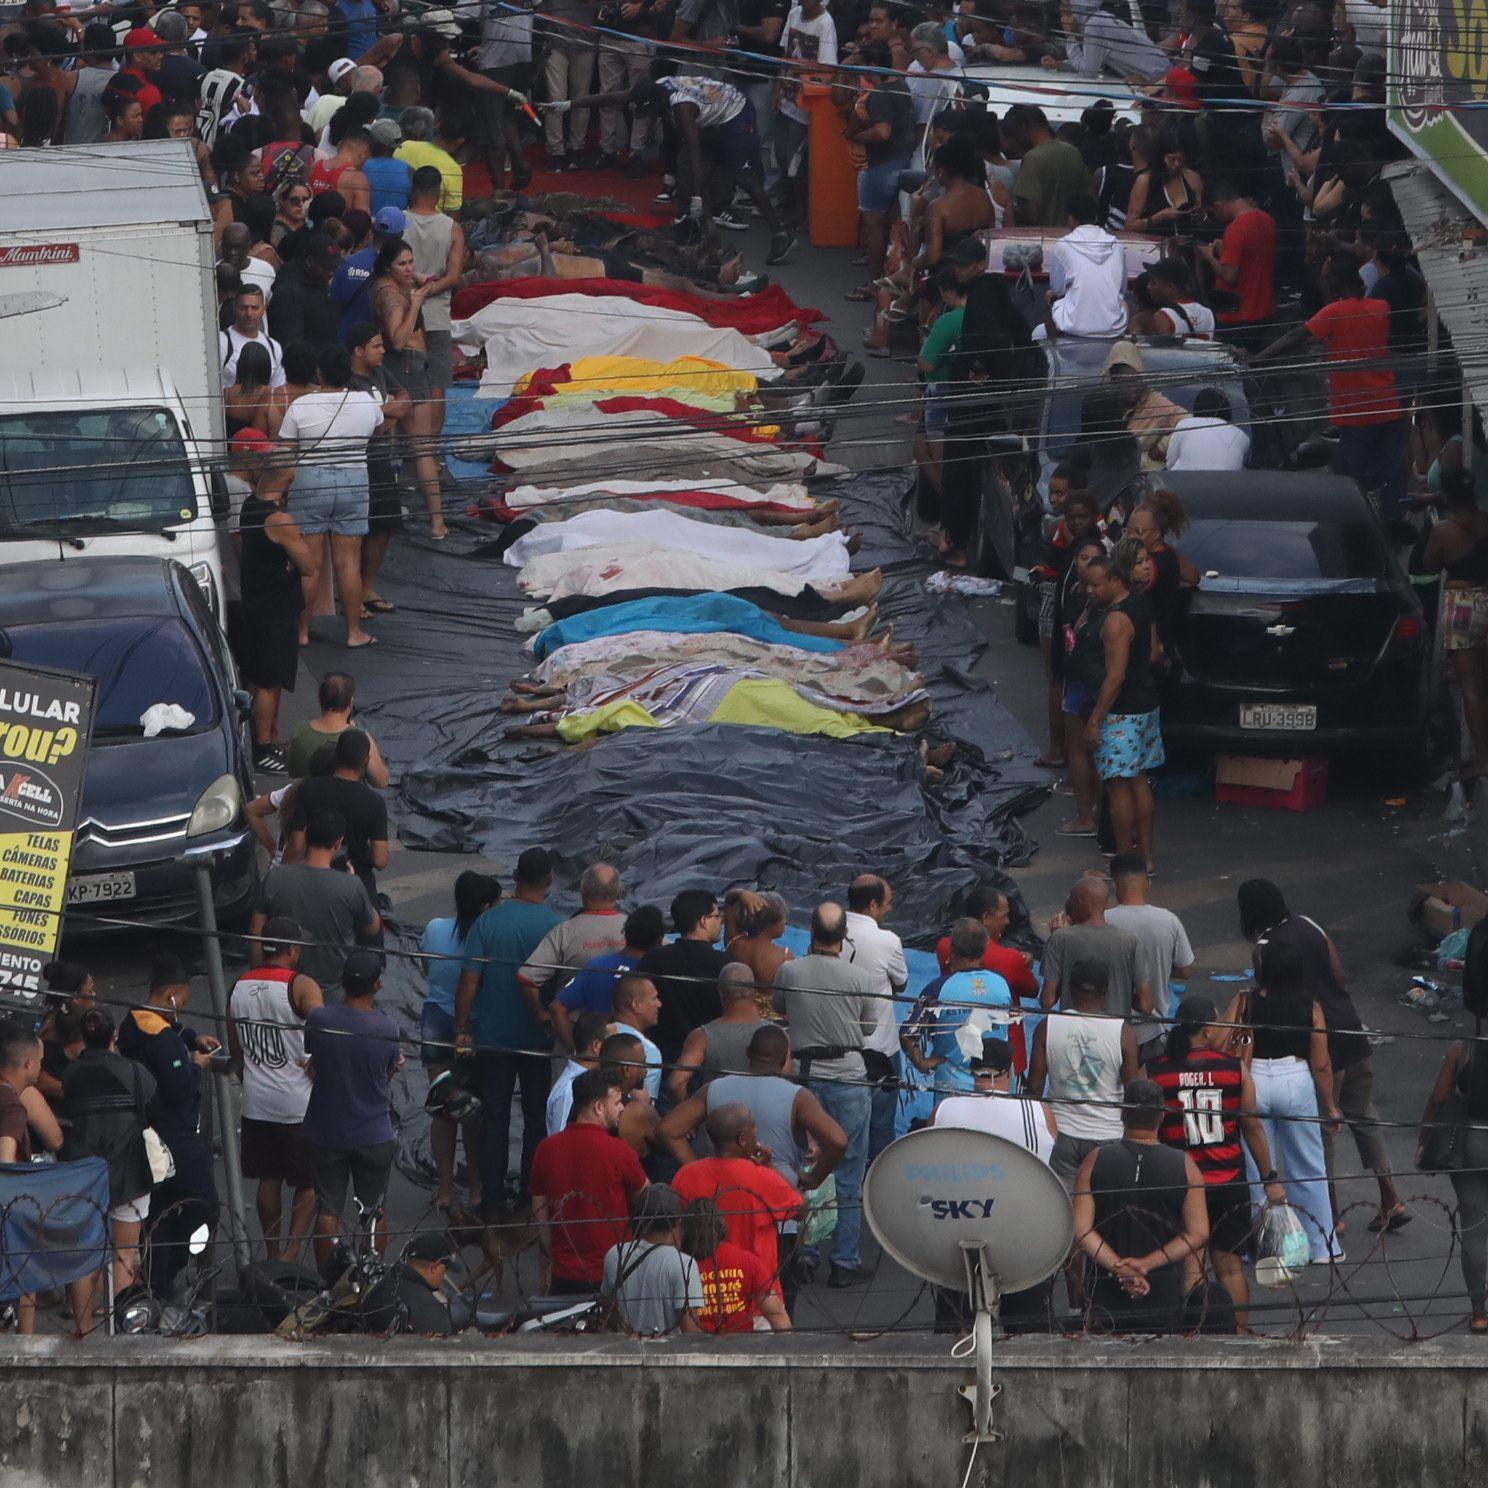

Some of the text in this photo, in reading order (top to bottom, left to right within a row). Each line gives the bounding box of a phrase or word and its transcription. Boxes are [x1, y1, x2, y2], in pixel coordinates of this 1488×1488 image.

[0, 246, 72, 263] Mambrini
[23, 802, 36, 812] NA
[37, 805, 59, 820] HORA
[27, 834, 61, 853] TELAS
[2, 846, 58, 871] CÂMERAS
[0, 868, 55, 890] BATERIAS
[13, 889, 52, 909] CAPAS
[1177, 1089, 1225, 1146] 10
[930, 1197, 995, 1220] SKY
